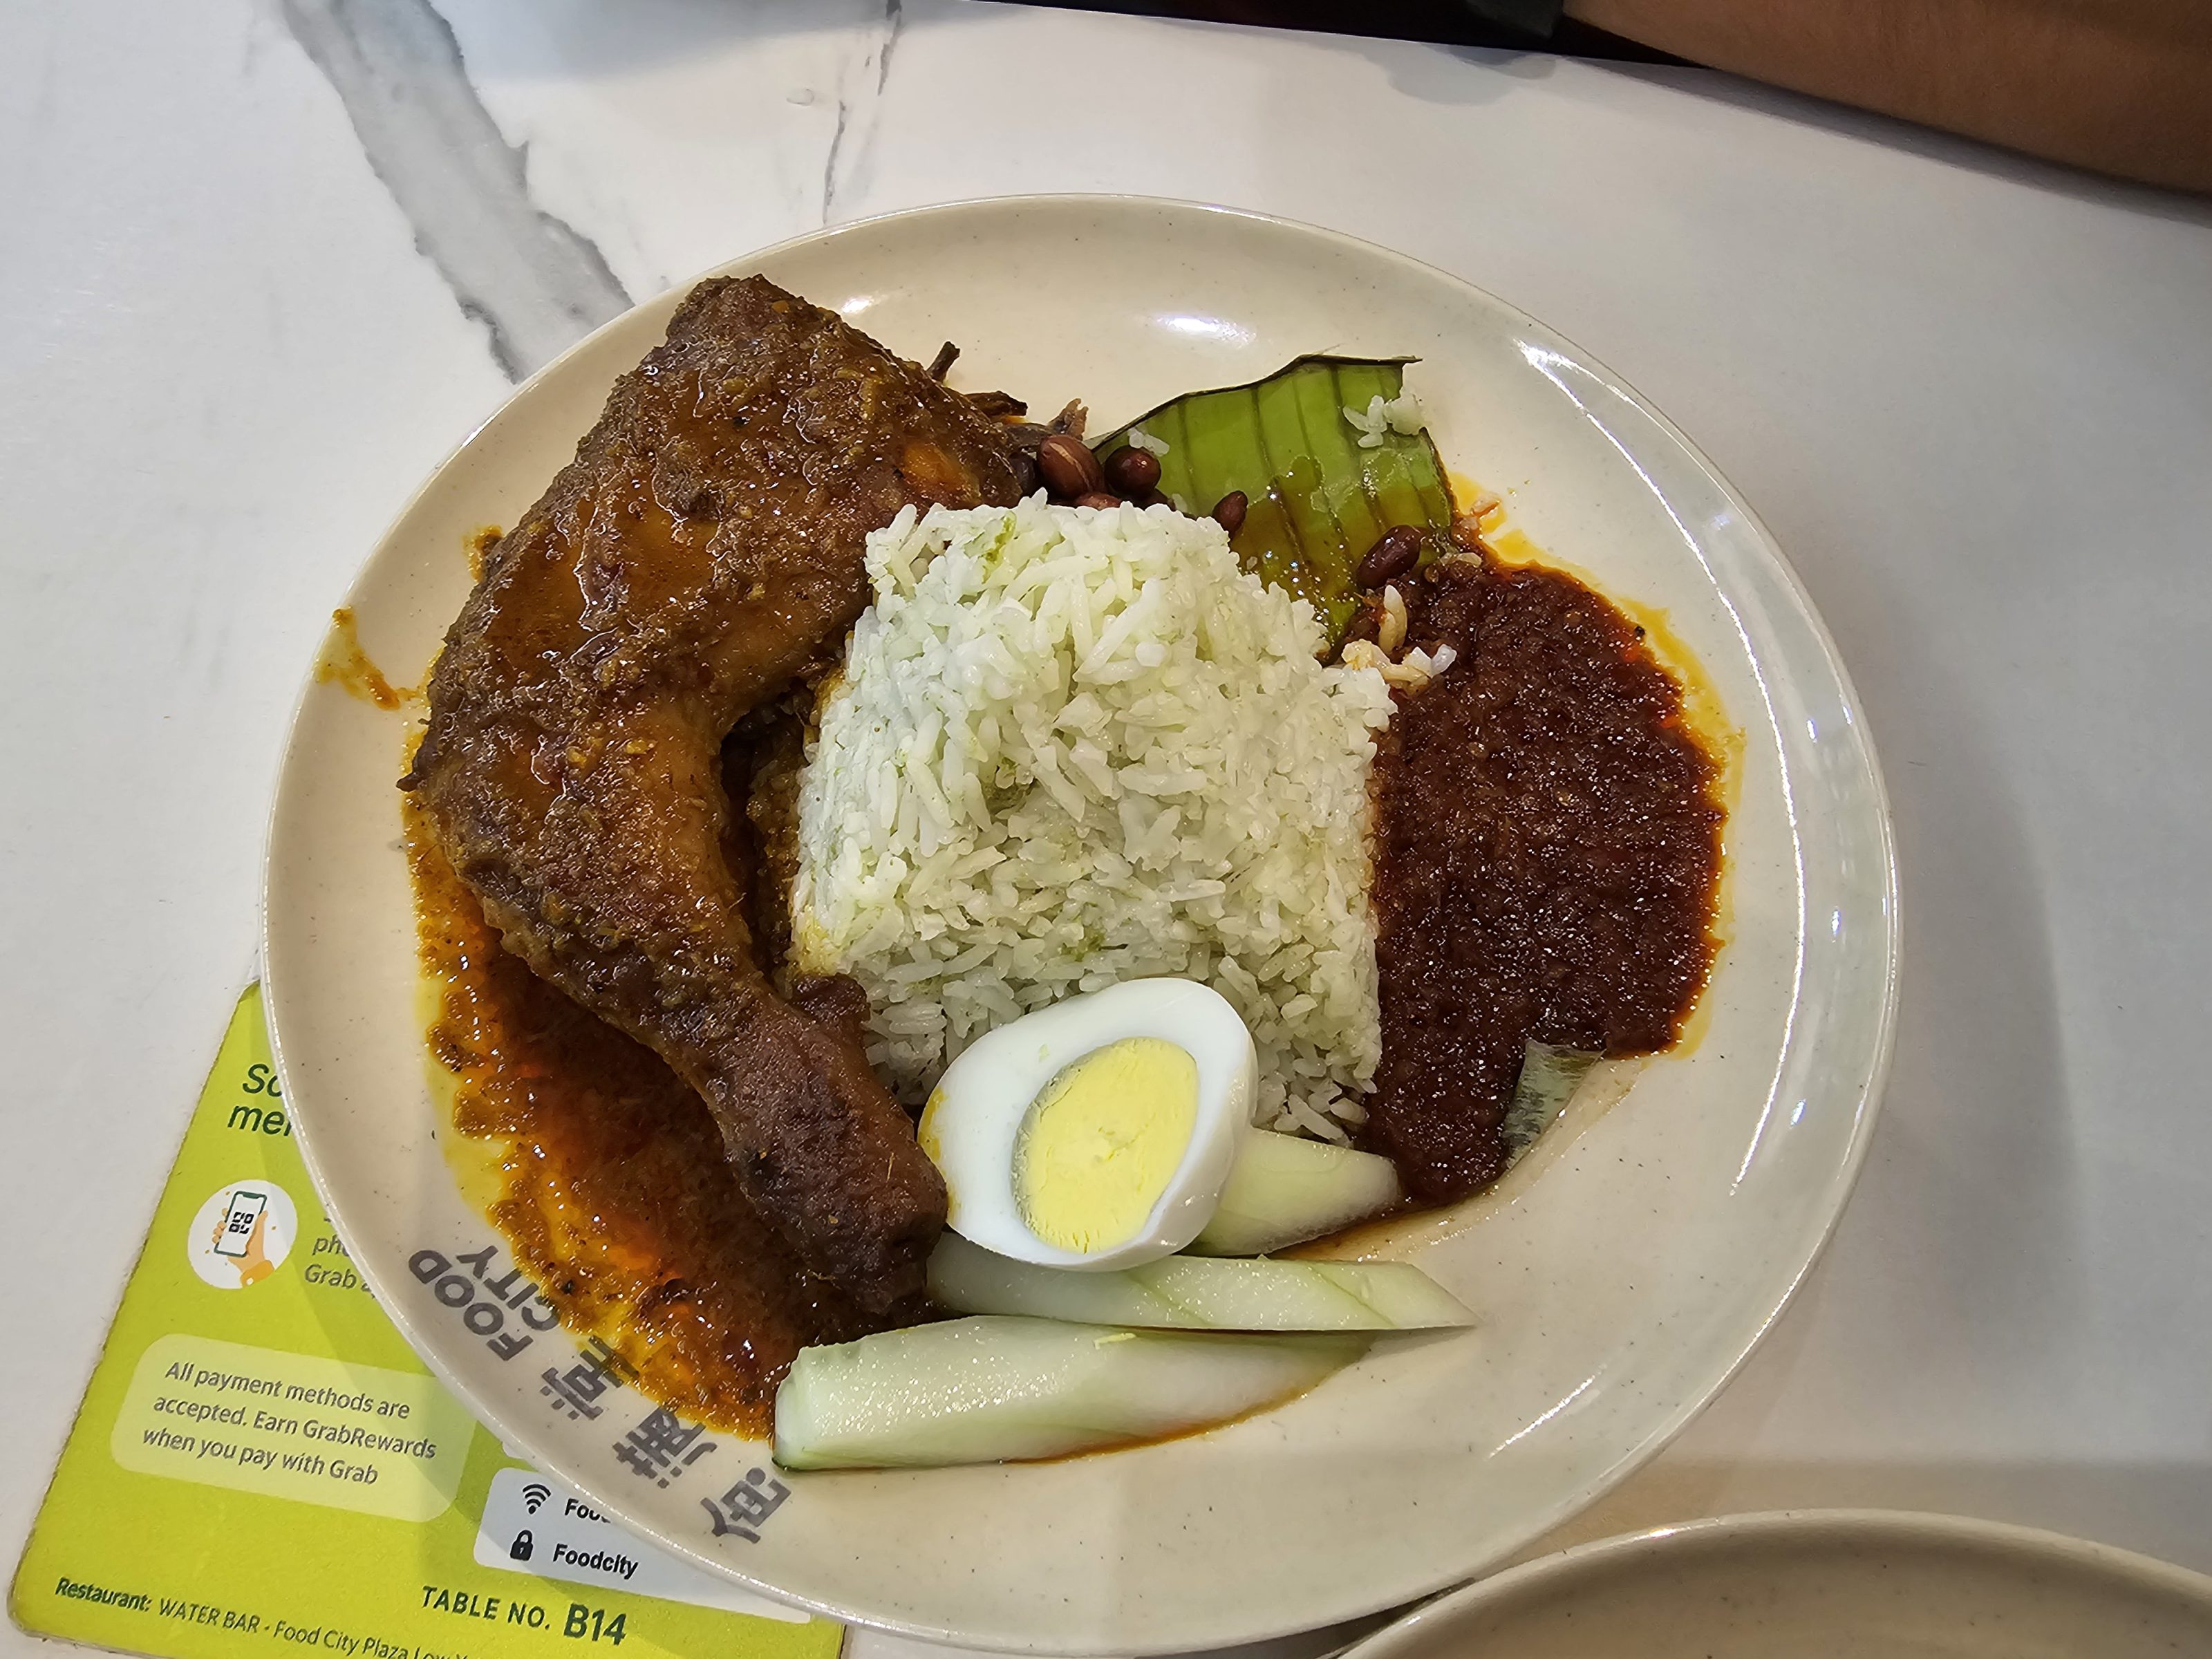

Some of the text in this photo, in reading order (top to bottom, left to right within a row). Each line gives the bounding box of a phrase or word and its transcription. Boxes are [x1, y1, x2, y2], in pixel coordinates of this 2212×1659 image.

[305, 1264, 357, 1289] Grab
[409, 1250, 534, 1361] FOOD
[456, 1245, 561, 1331] CITY
[165, 1362, 410, 1419] All payment methods are
[143, 1427, 378, 1485] when you pay with Grab
[153, 1396, 437, 1459] accepted. Earn GrabRewards
[55, 1577, 153, 1612] Restaurant:
[158, 1598, 221, 1626] WATER
[223, 1611, 261, 1633] BAR
[274, 1620, 322, 1645] Food
[324, 1627, 360, 1656] City
[362, 1636, 409, 1659] Plaza
[422, 1585, 627, 1645] TABLE NO. B14
